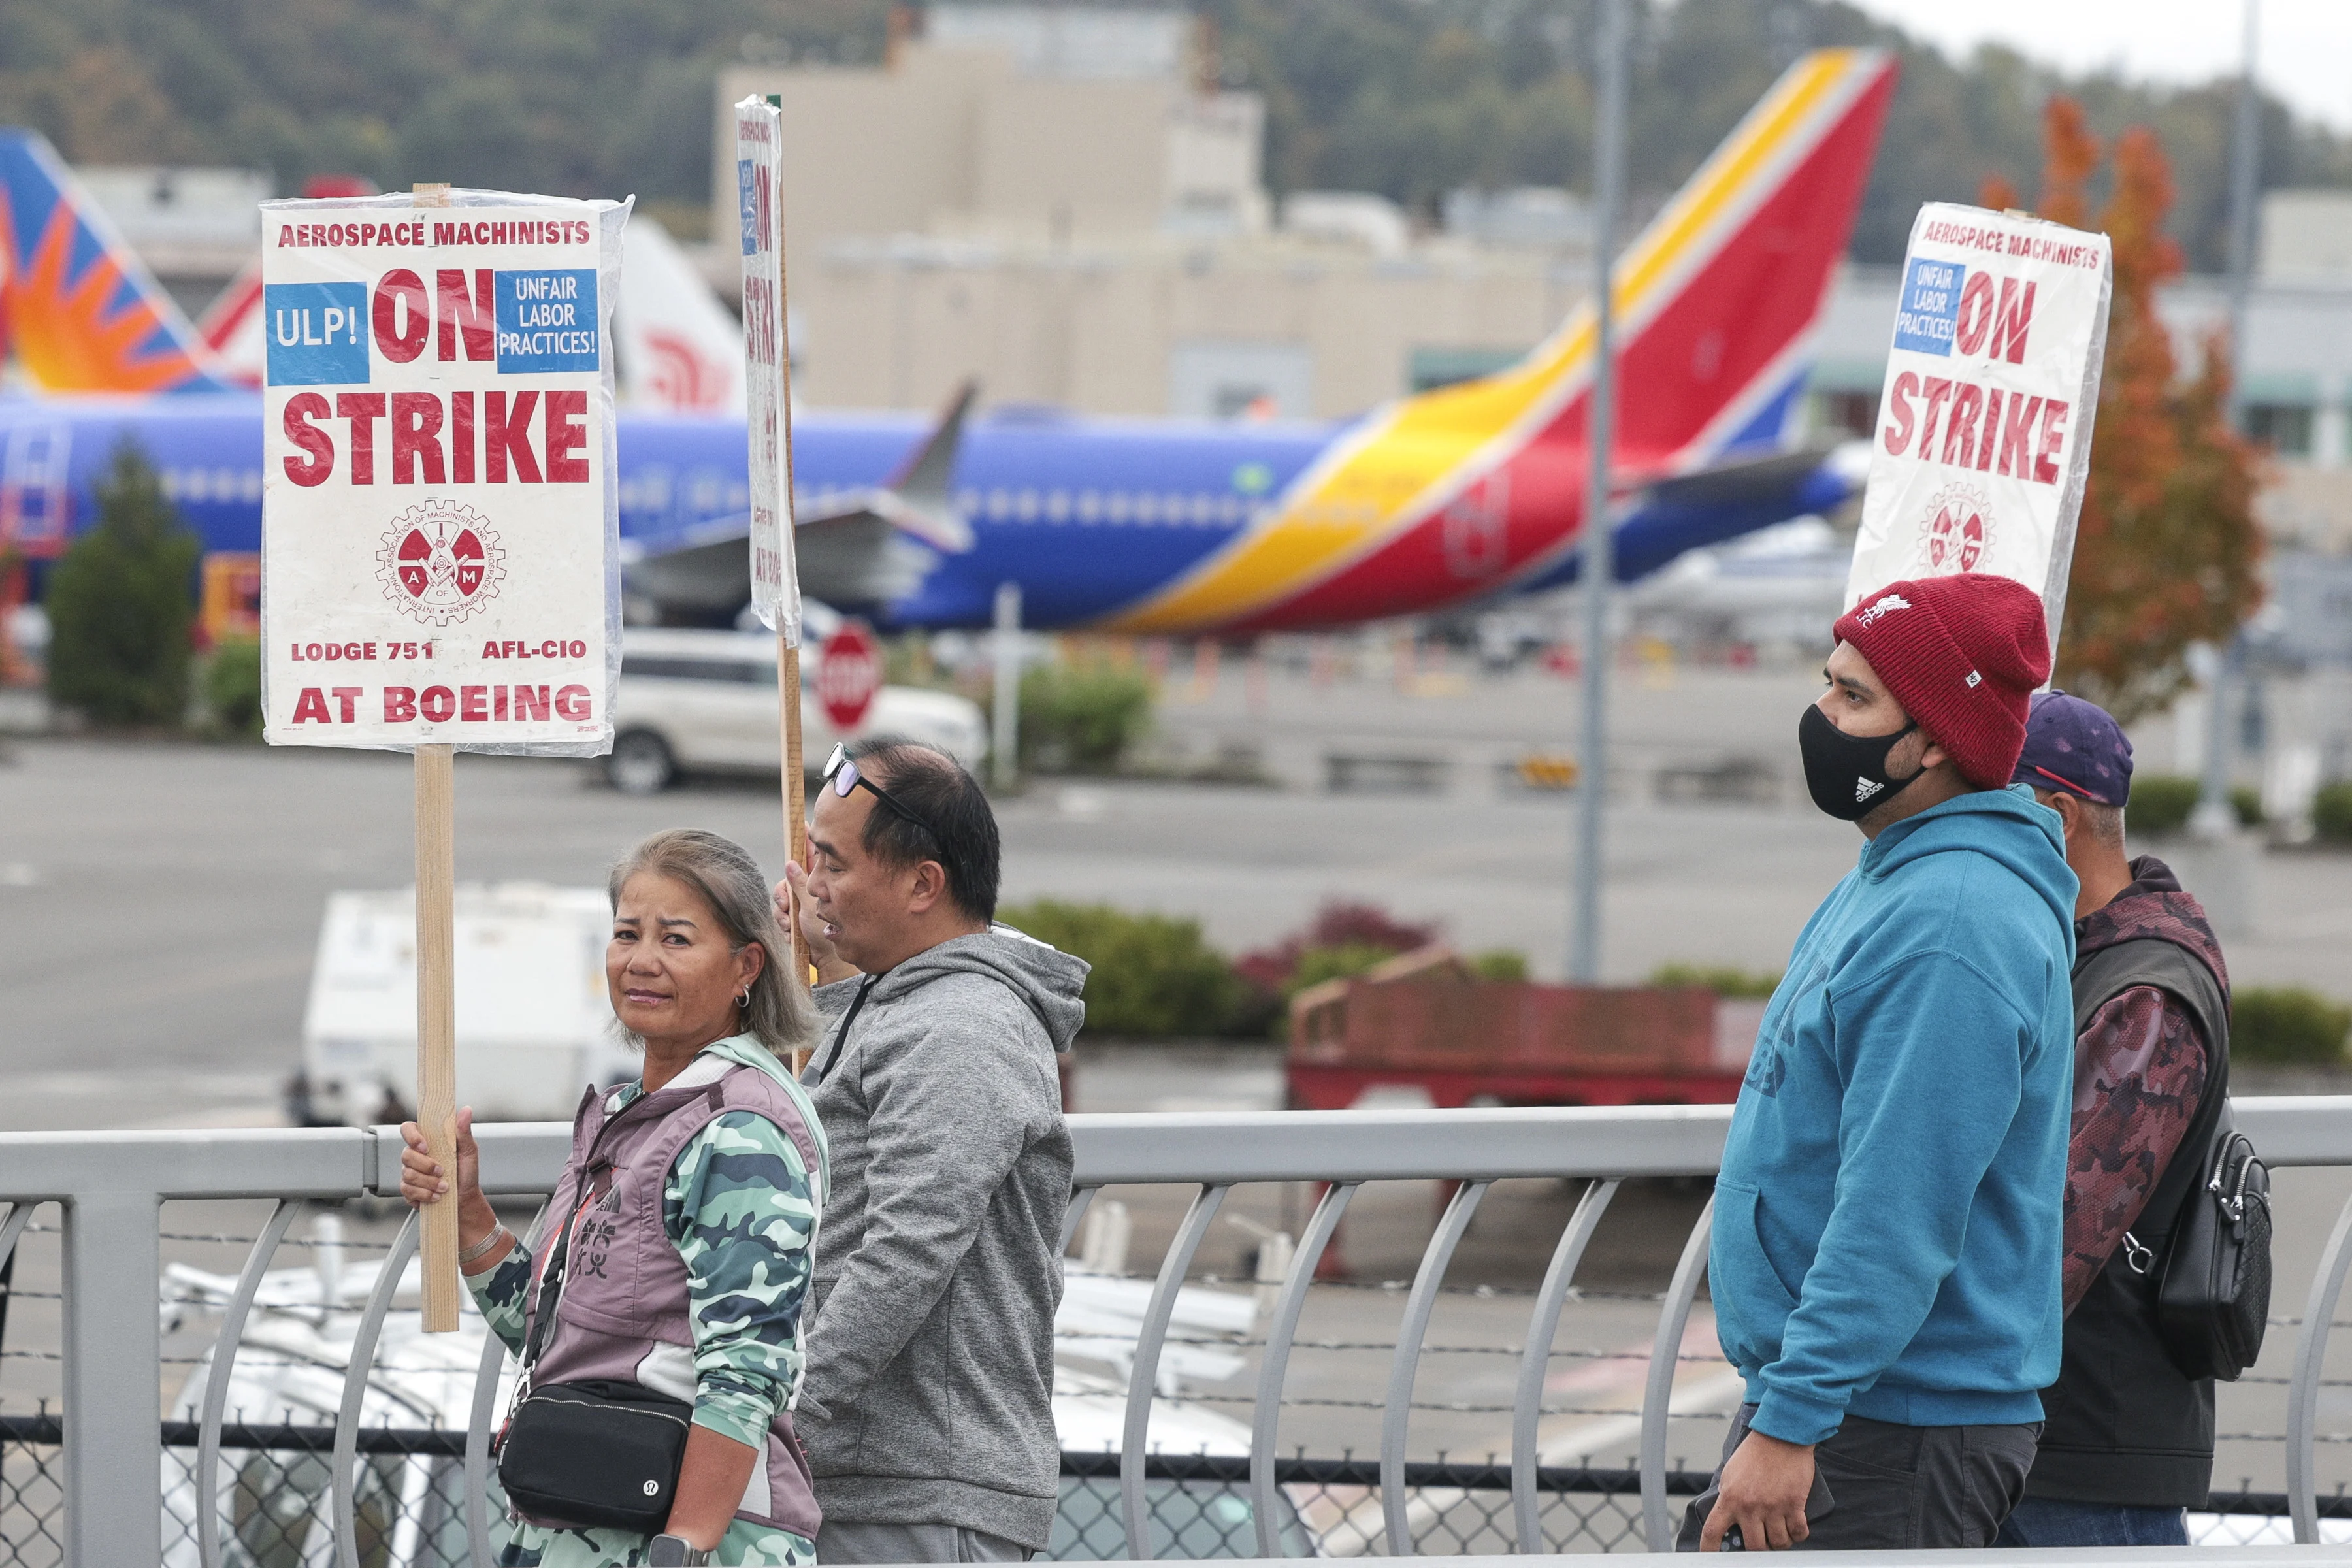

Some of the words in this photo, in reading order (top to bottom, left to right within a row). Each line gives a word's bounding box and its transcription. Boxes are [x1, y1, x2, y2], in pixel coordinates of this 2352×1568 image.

[278, 222, 425, 248] AEROSPACE
[434, 221, 590, 246] MACHINISTS
[1923, 221, 2004, 252] AEROSPACE
[2008, 235, 2099, 269] MACHINISTS
[515, 276, 578, 301] UNFAIR
[1917, 265, 1953, 289] UNFAIR
[1913, 289, 1948, 313] LABOR
[276, 306, 357, 347] ULP!
[372, 268, 495, 363] ON
[519, 303, 576, 327] LABOR
[1899, 312, 1955, 340] PRACTICES!
[1956, 271, 2037, 364] ON
[499, 331, 595, 356] PRACTICES!
[283, 390, 590, 487] STRIKE
[1885, 371, 2069, 485] STRIKE
[414, 515, 425, 523] OF
[427, 511, 474, 528] MACHINISTS
[387, 521, 415, 568] ASSOCIATION
[474, 527, 487, 542] AND
[408, 570, 419, 583] A
[462, 570, 476, 583] M
[482, 542, 495, 591] AEROSPACE
[389, 569, 434, 614] INTERNATIONAL
[448, 590, 485, 614] WORKERS
[291, 642, 377, 661] LODGE
[387, 642, 433, 660] 751
[482, 640, 587, 659] AFL-CIO
[291, 687, 363, 724] AT
[384, 684, 592, 723] BOEING
[1856, 782, 1884, 802] adidas
